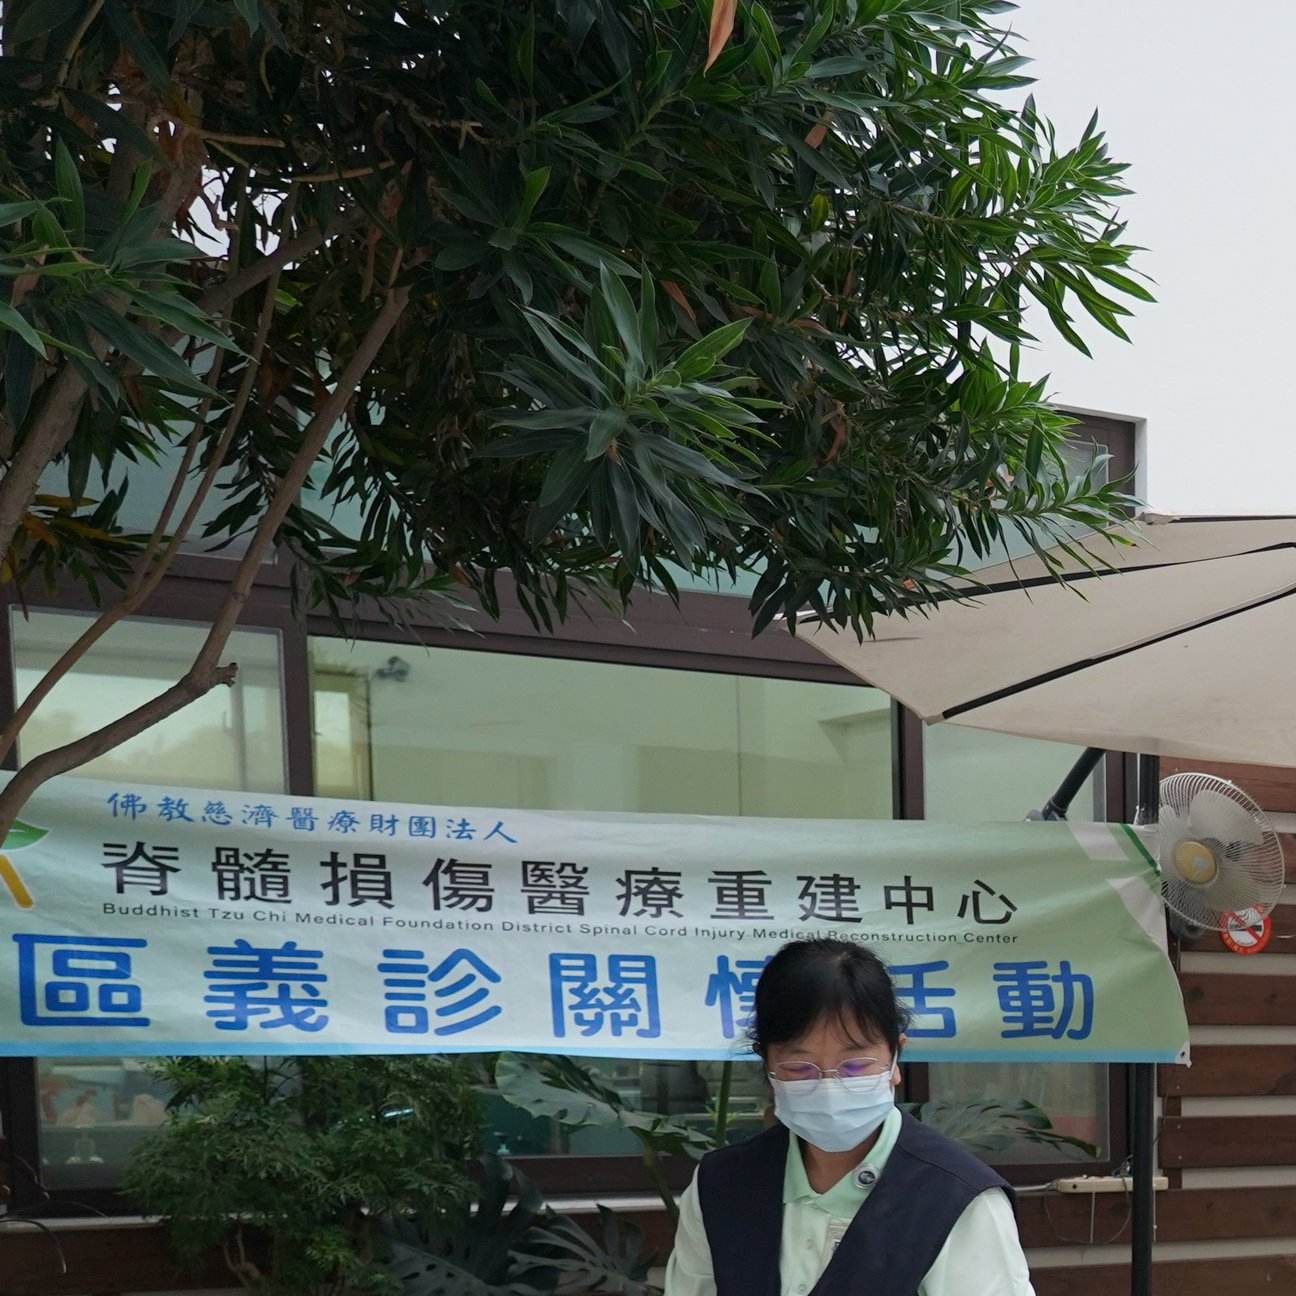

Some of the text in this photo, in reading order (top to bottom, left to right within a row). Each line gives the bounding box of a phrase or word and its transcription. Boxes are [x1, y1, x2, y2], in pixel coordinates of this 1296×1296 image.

[106, 791, 519, 844] 佛教慈濟醫療財團法人
[101, 841, 1019, 925] 脊髓損傷醫療重建中心
[103, 903, 1018, 944] Buddhist Tzu Chi Medical Foundation District Spinal Cord Injury Medical Reconstruction Center
